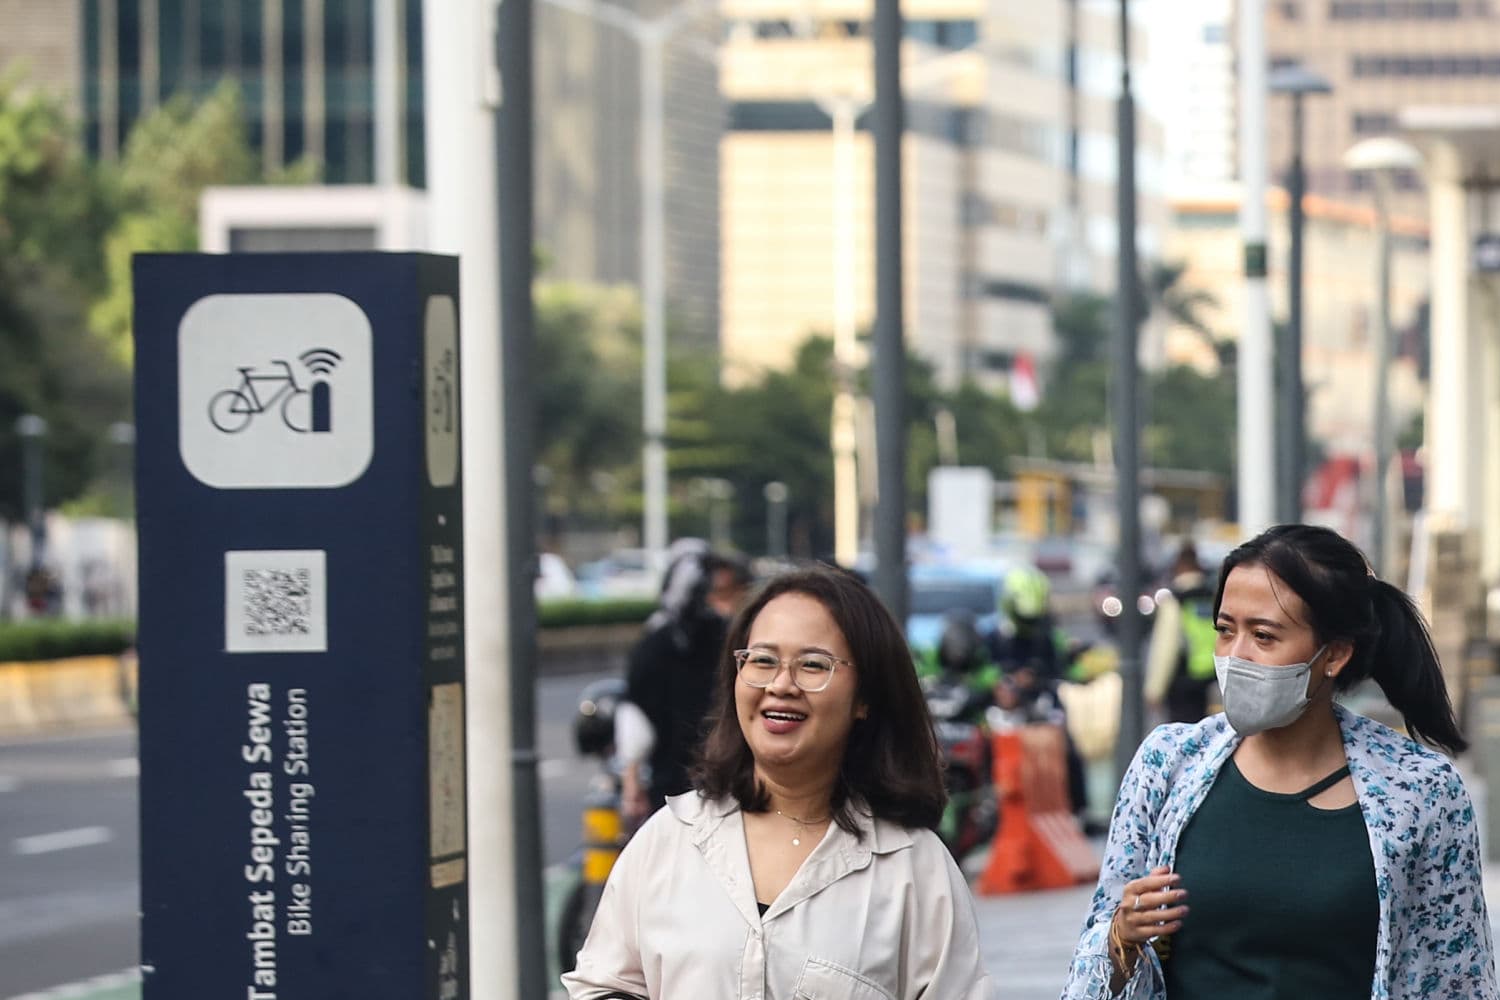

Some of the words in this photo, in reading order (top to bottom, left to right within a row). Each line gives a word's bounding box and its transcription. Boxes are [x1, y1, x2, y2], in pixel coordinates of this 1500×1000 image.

[242, 682, 272, 764] Sewa
[282, 687, 309, 776] Station
[243, 771, 280, 883] Sepeda
[284, 782, 315, 876] Sharing
[287, 882, 312, 936] Bike
